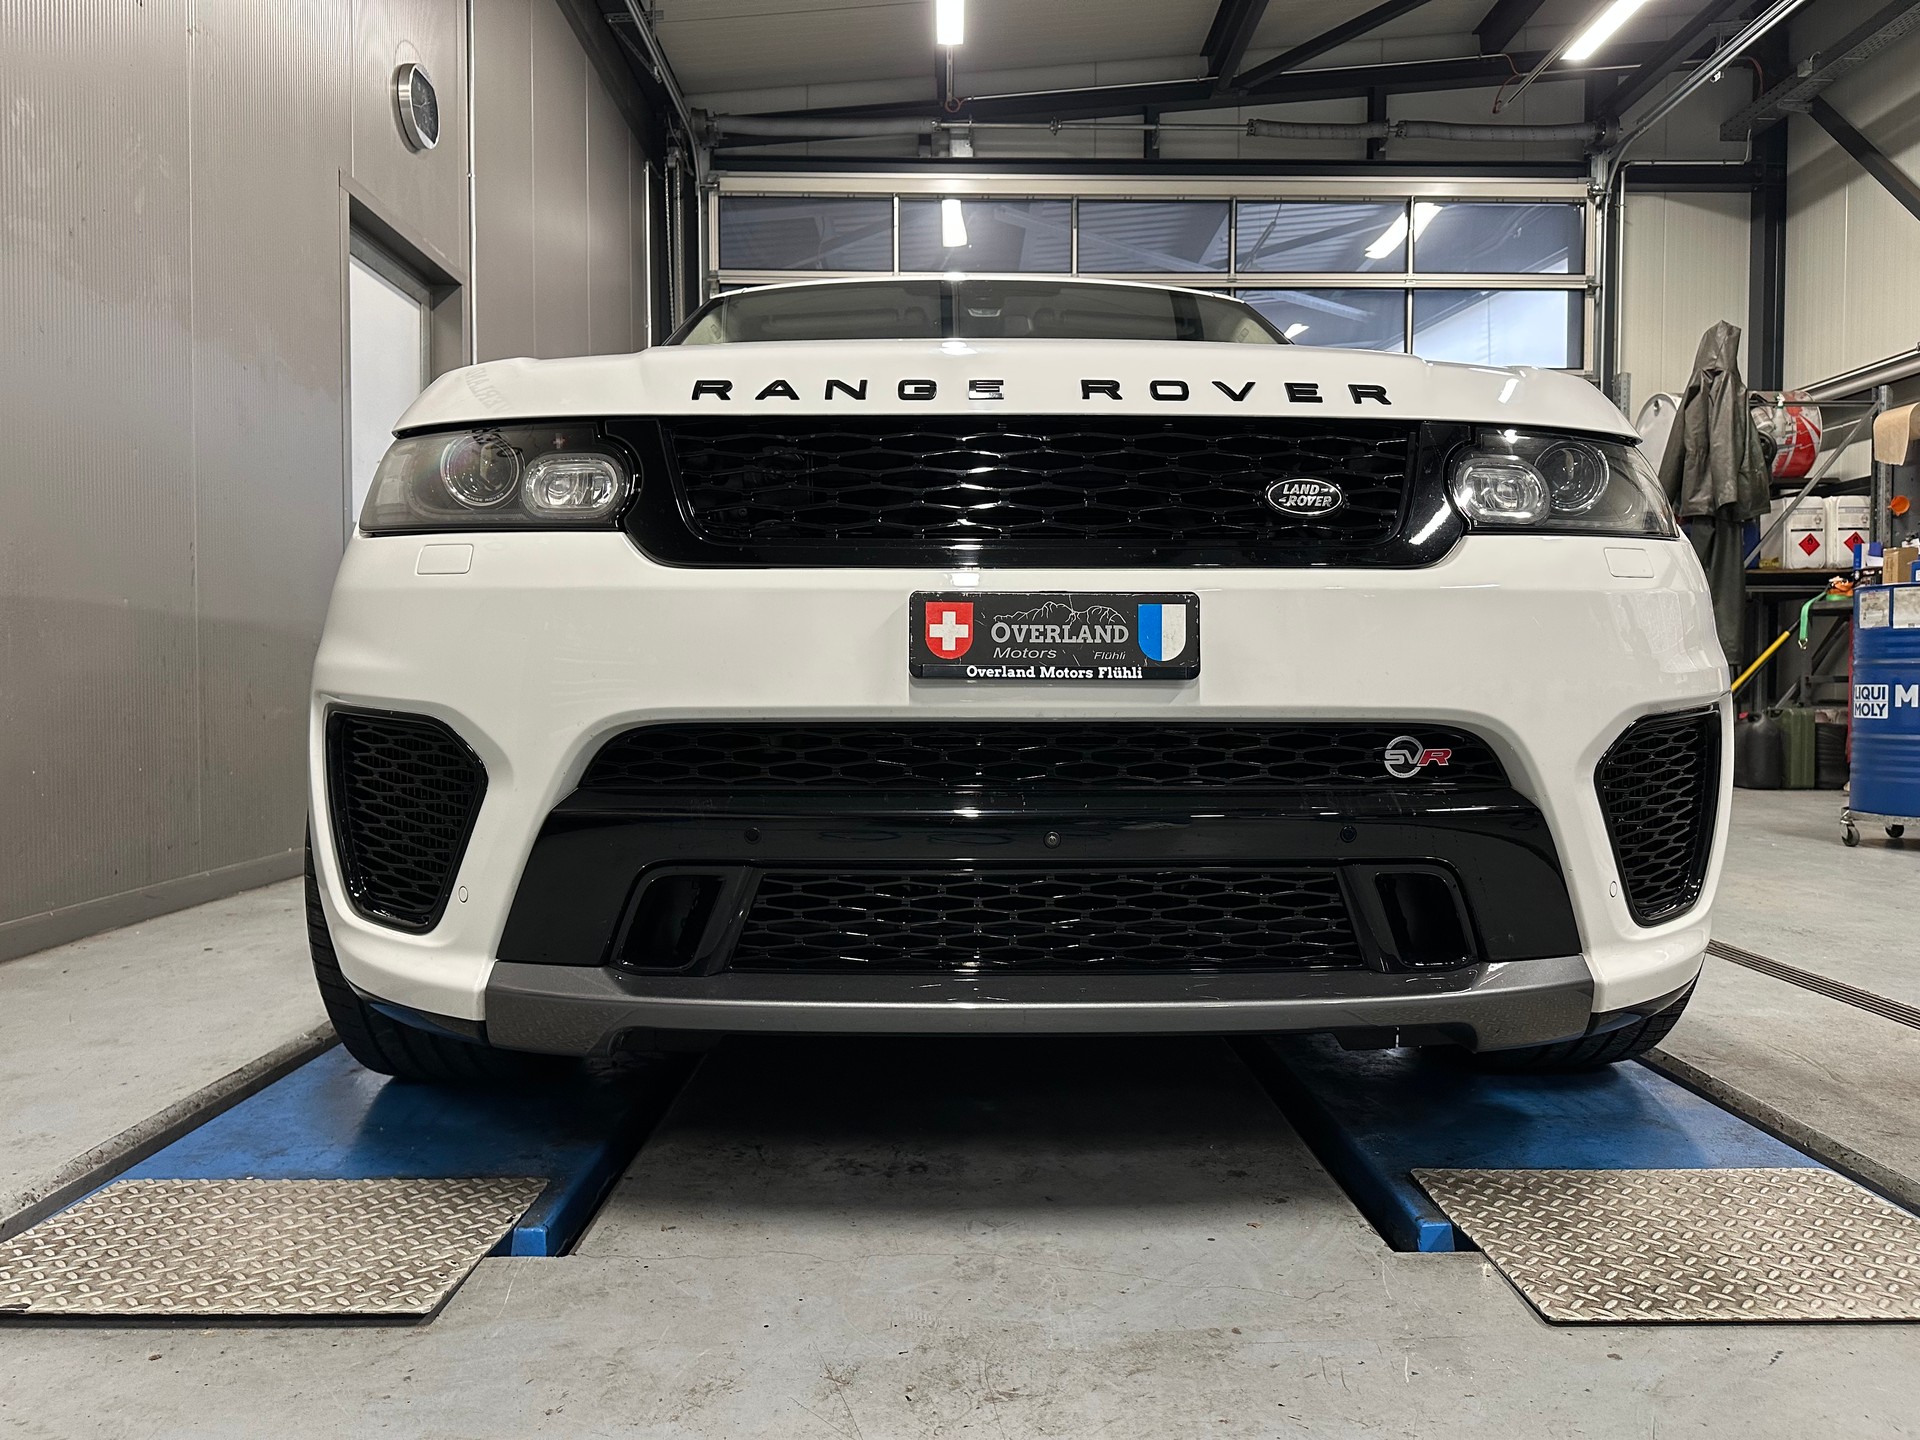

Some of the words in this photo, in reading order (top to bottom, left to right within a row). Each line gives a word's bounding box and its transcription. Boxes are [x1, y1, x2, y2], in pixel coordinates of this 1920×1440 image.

[691, 379, 1005, 401] RANGE
[1080, 379, 1393, 406] ROVER
[1283, 484, 1320, 495] LAND
[484, 492, 504, 502] ROVER
[1285, 495, 1332, 507] ROVER
[990, 623, 1129, 643] OVERLAND
[993, 647, 1057, 659] Motors
[1093, 651, 1127, 660] Flühli
[966, 666, 1036, 678] Overland
[1039, 667, 1093, 679] Motors
[1097, 667, 1142, 679] Flühli
[1855, 686, 1886, 700] LIQUI
[1854, 703, 1887, 717] MOLY
[1384, 735, 1452, 778] SVR
